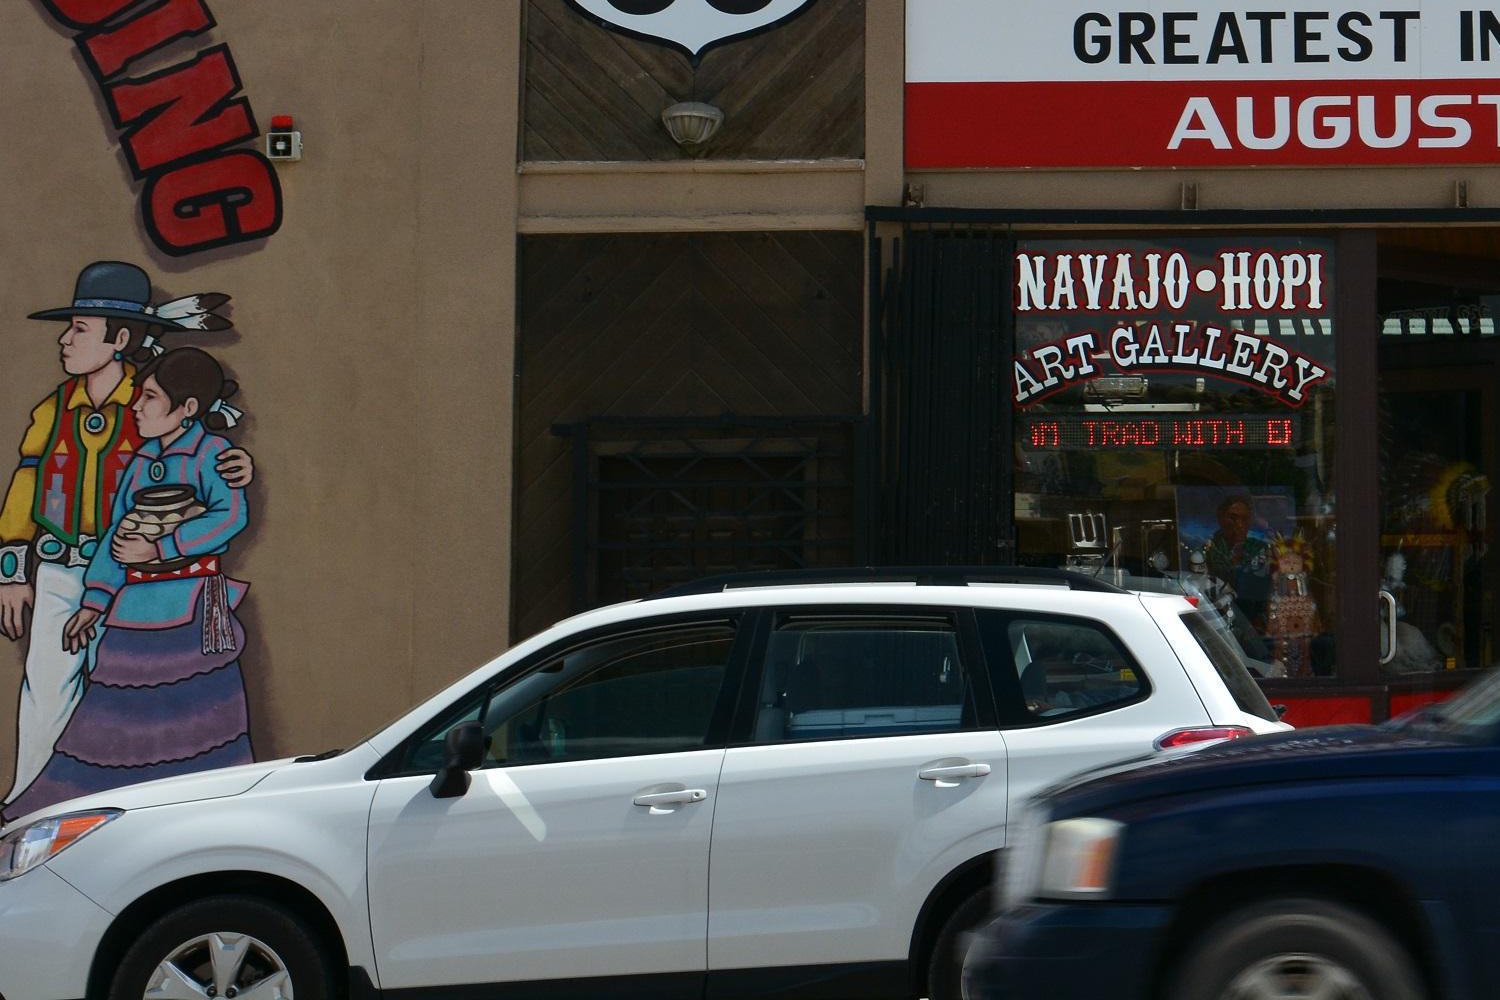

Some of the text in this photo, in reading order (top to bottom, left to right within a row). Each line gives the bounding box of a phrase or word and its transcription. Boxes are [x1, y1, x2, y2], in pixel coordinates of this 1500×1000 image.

[1074, 11, 1420, 64] GREATEST
[1015, 324, 1326, 402] ART GALLERY
[1082, 421, 1159, 445] TRAD
[1174, 420, 1245, 445] WITH
